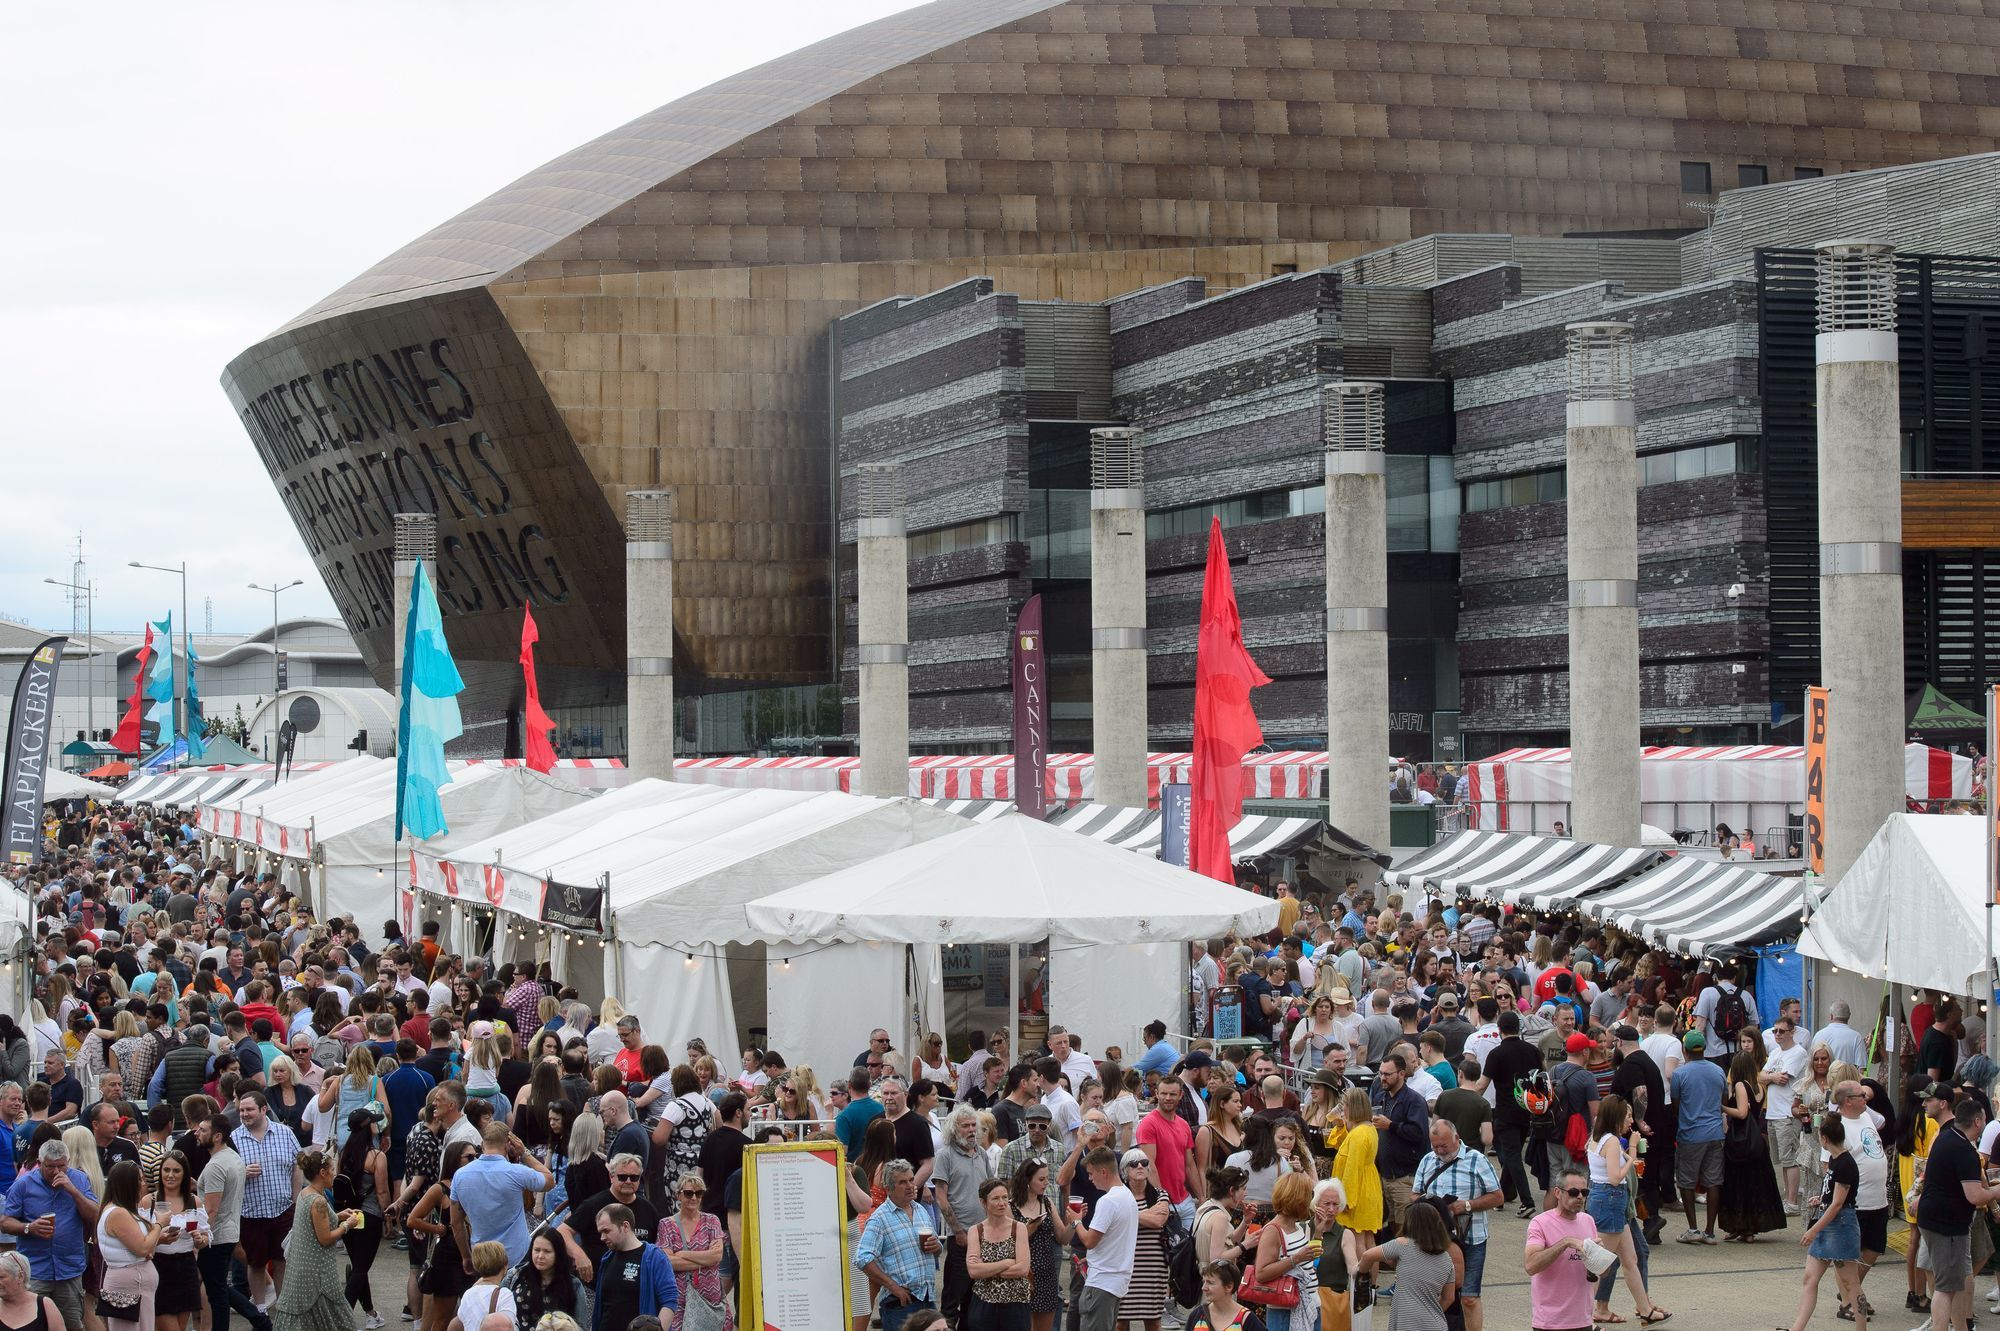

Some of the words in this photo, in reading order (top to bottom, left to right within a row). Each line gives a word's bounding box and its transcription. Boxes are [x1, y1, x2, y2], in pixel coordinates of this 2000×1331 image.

[322, 338, 474, 444] STONES
[443, 523, 569, 612] SING
[11, 662, 51, 845] FLAPJACKERY
[1389, 712, 1424, 731] AFFI
[1808, 698, 1826, 860] BAR
